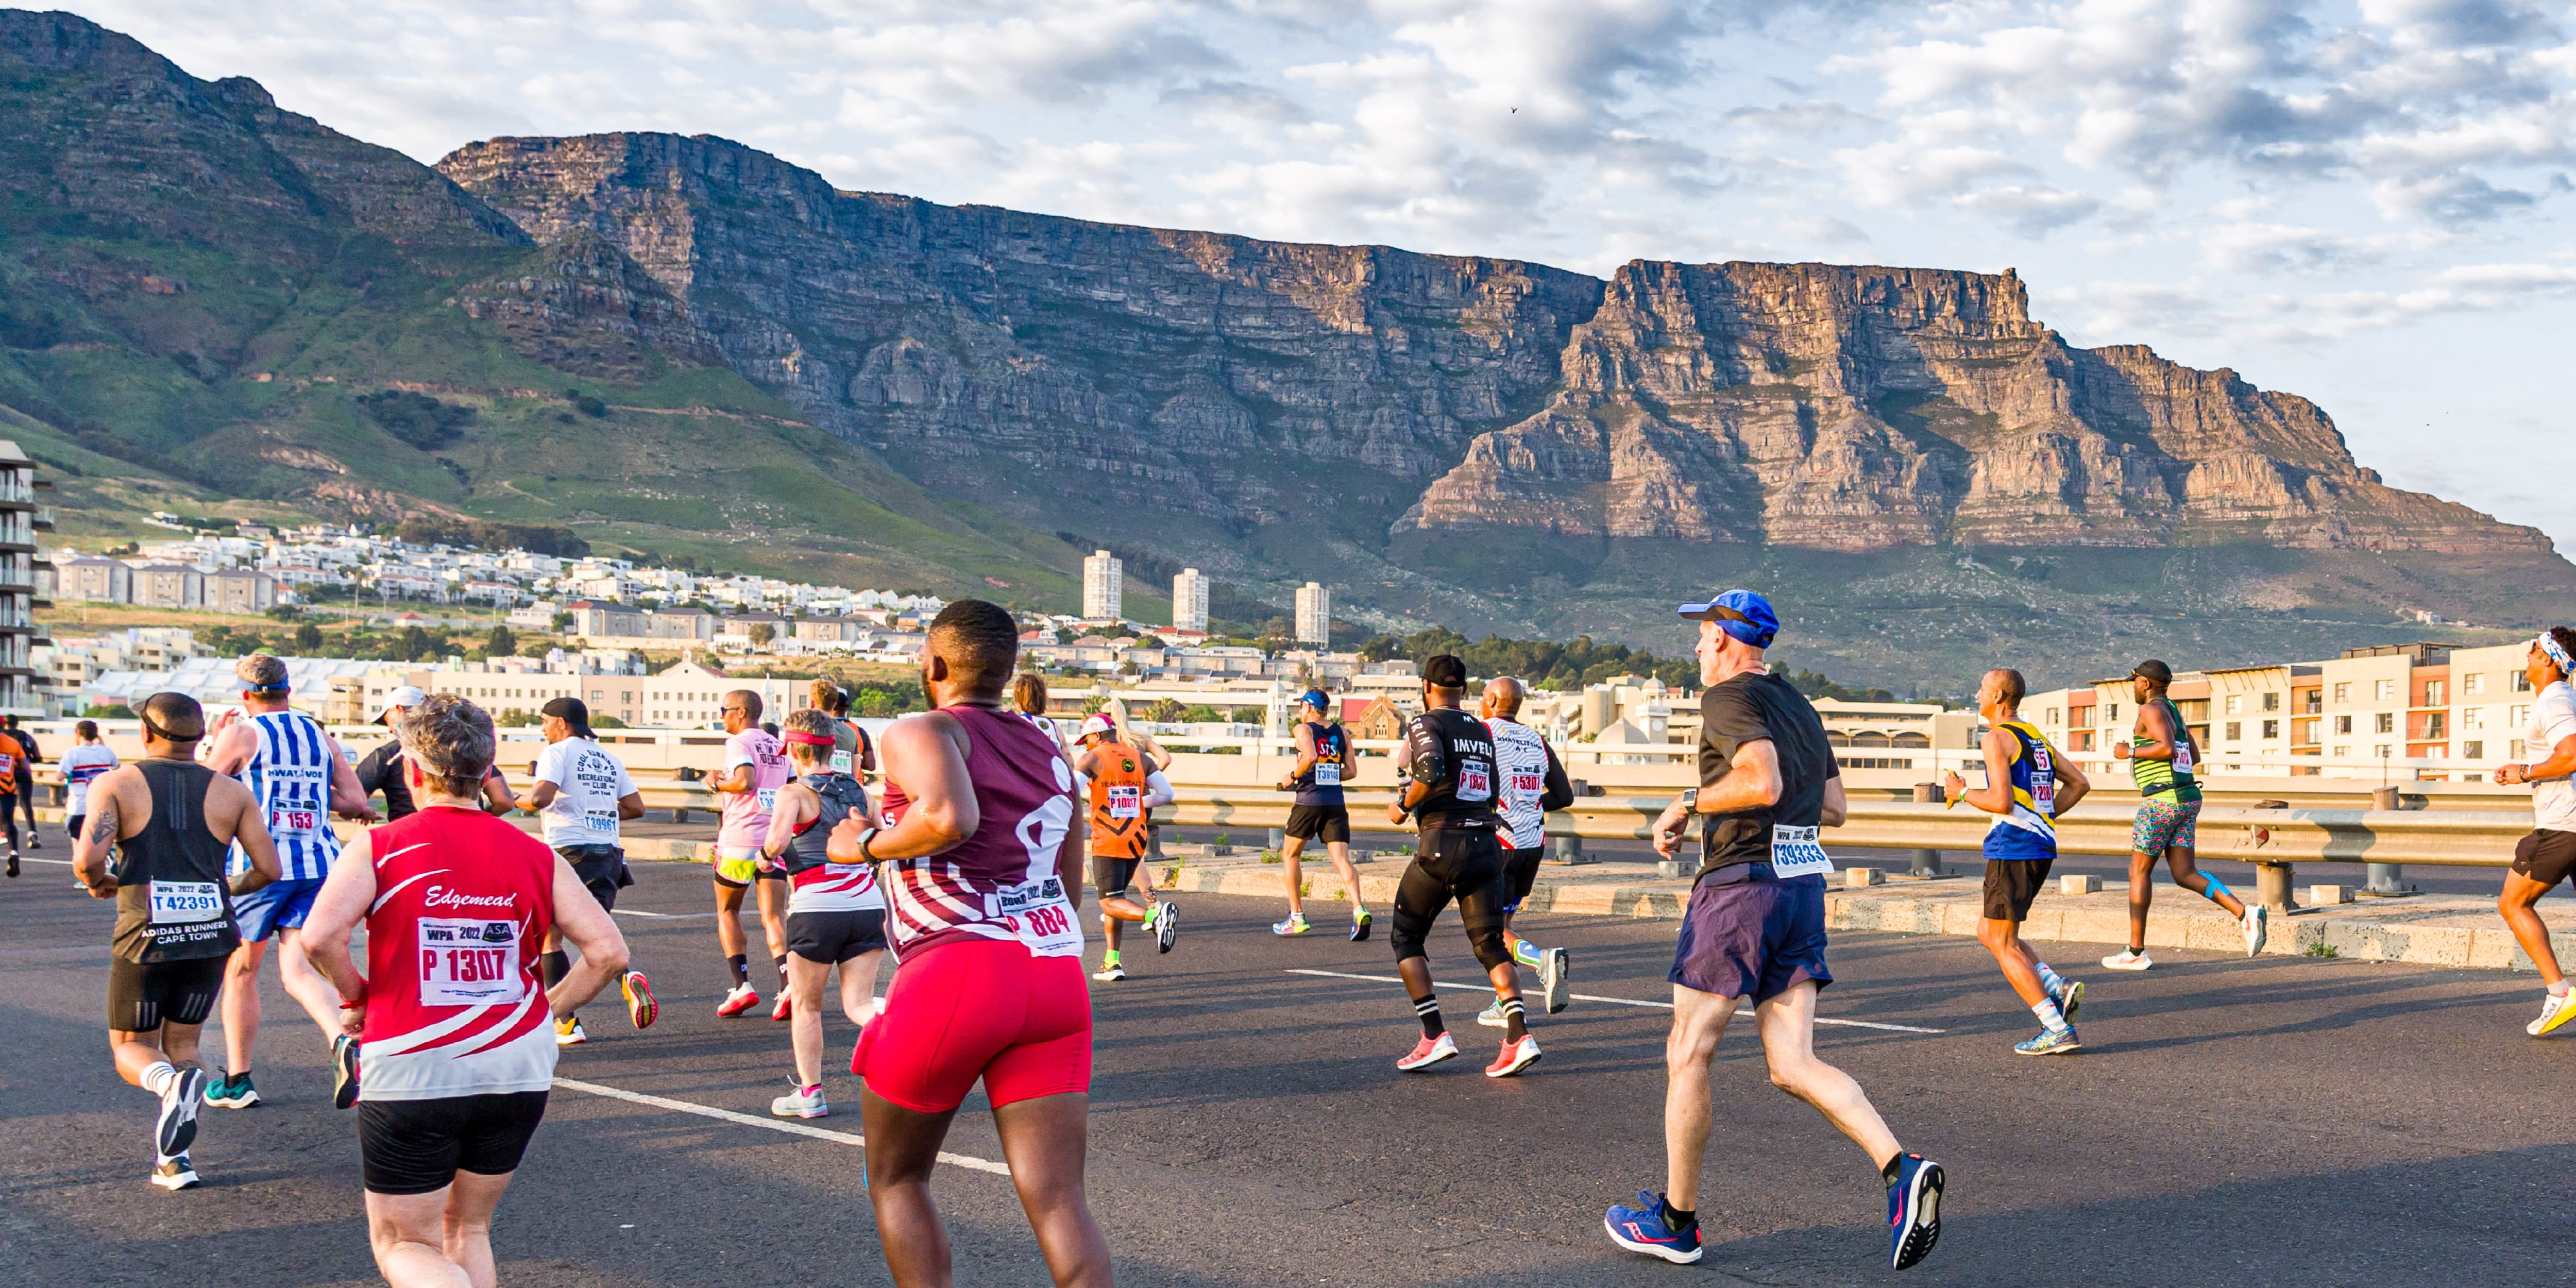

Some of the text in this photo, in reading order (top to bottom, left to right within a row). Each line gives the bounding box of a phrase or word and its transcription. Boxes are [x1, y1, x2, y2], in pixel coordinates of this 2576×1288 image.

[1497, 737, 1543, 750] KHAYELITSHA
[577, 754, 588, 772] COOL
[1460, 772, 1467, 787] P
[1512, 776, 1517, 789] P
[2032, 786, 2037, 801] P
[1110, 798, 1115, 808] P
[273, 811, 312, 829] P 153
[1777, 832, 1790, 840] WPA
[1044, 880, 1059, 891] ASA
[153, 896, 217, 910] T 42391
[425, 886, 517, 910] Edgemead
[1024, 905, 1071, 937] 884
[141, 921, 228, 938] ADIDAS RUNNERS
[427, 925, 510, 941] WPA 2022 ASA
[157, 931, 218, 944] CAPE TOWN
[423, 950, 506, 982] P 1307
